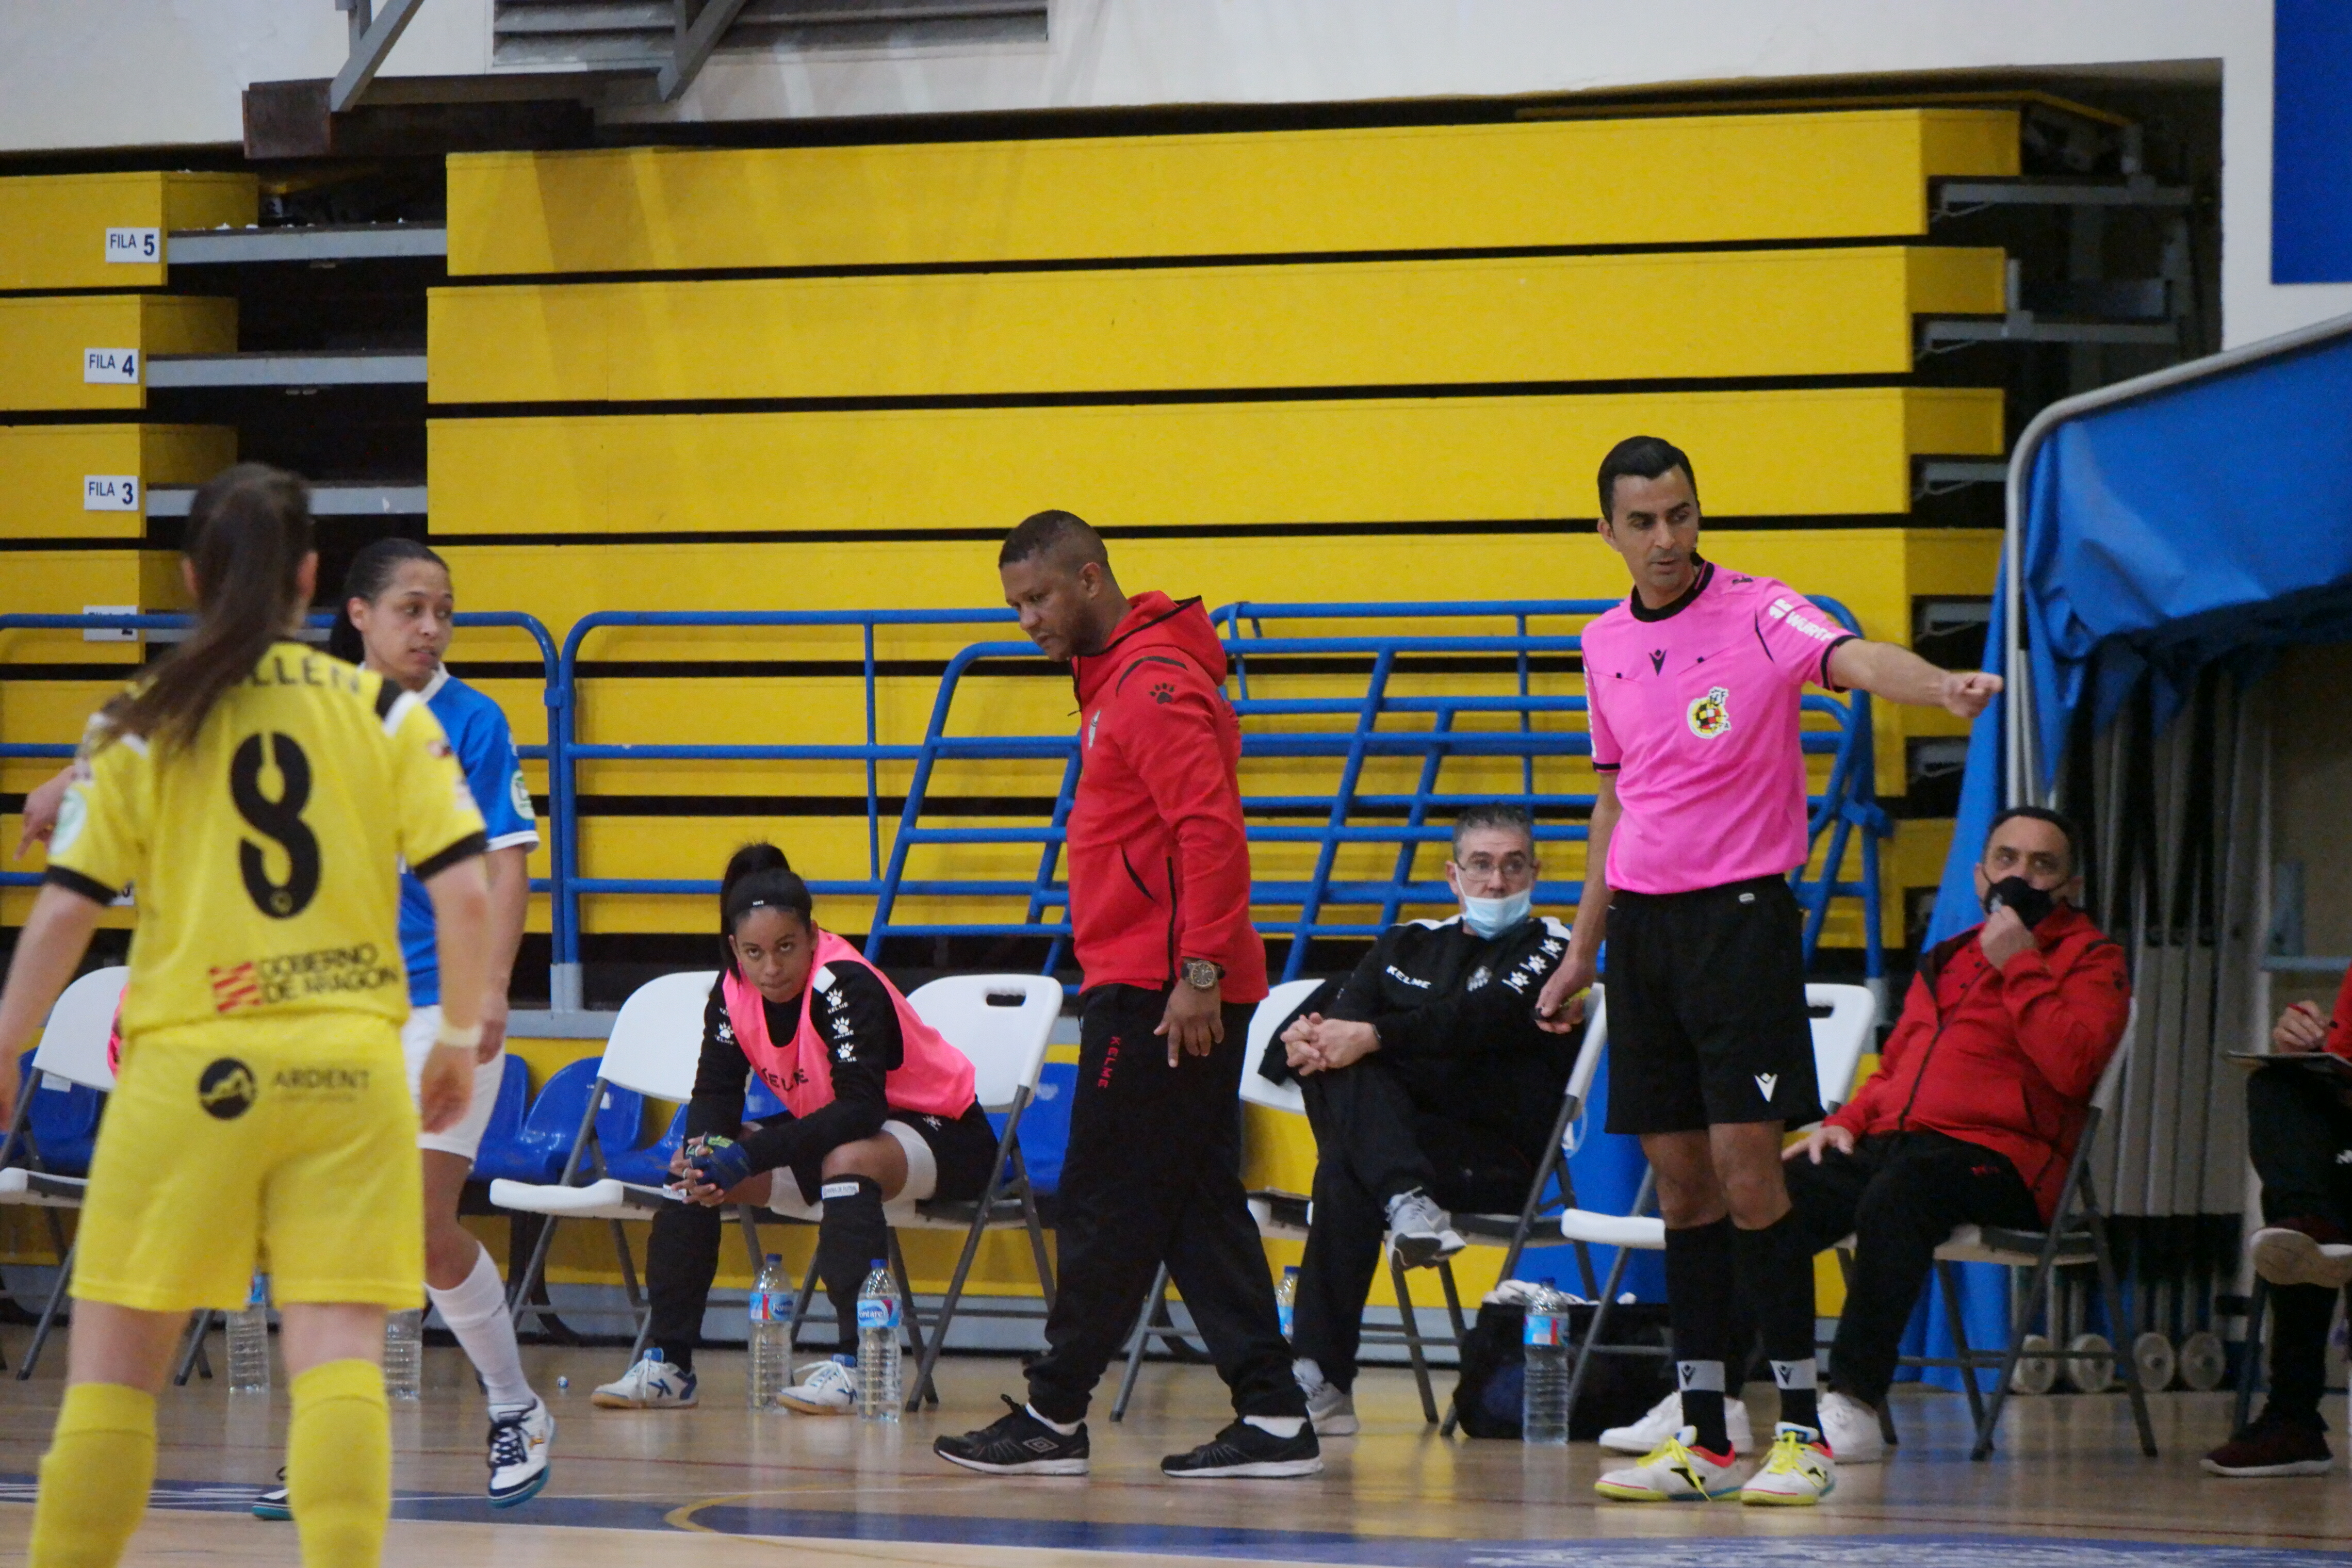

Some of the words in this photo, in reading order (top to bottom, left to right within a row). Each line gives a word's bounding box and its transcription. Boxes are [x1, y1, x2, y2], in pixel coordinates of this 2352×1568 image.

[110, 233, 137, 249] FILA
[144, 234, 155, 256] 5
[89, 354, 116, 369] FILA
[122, 354, 134, 377] 4
[89, 481, 115, 496] FILA
[122, 482, 134, 505] 3
[230, 731, 321, 920] 8
[1386, 965, 1431, 989] KELME
[1098, 1036, 1121, 1088] KELME
